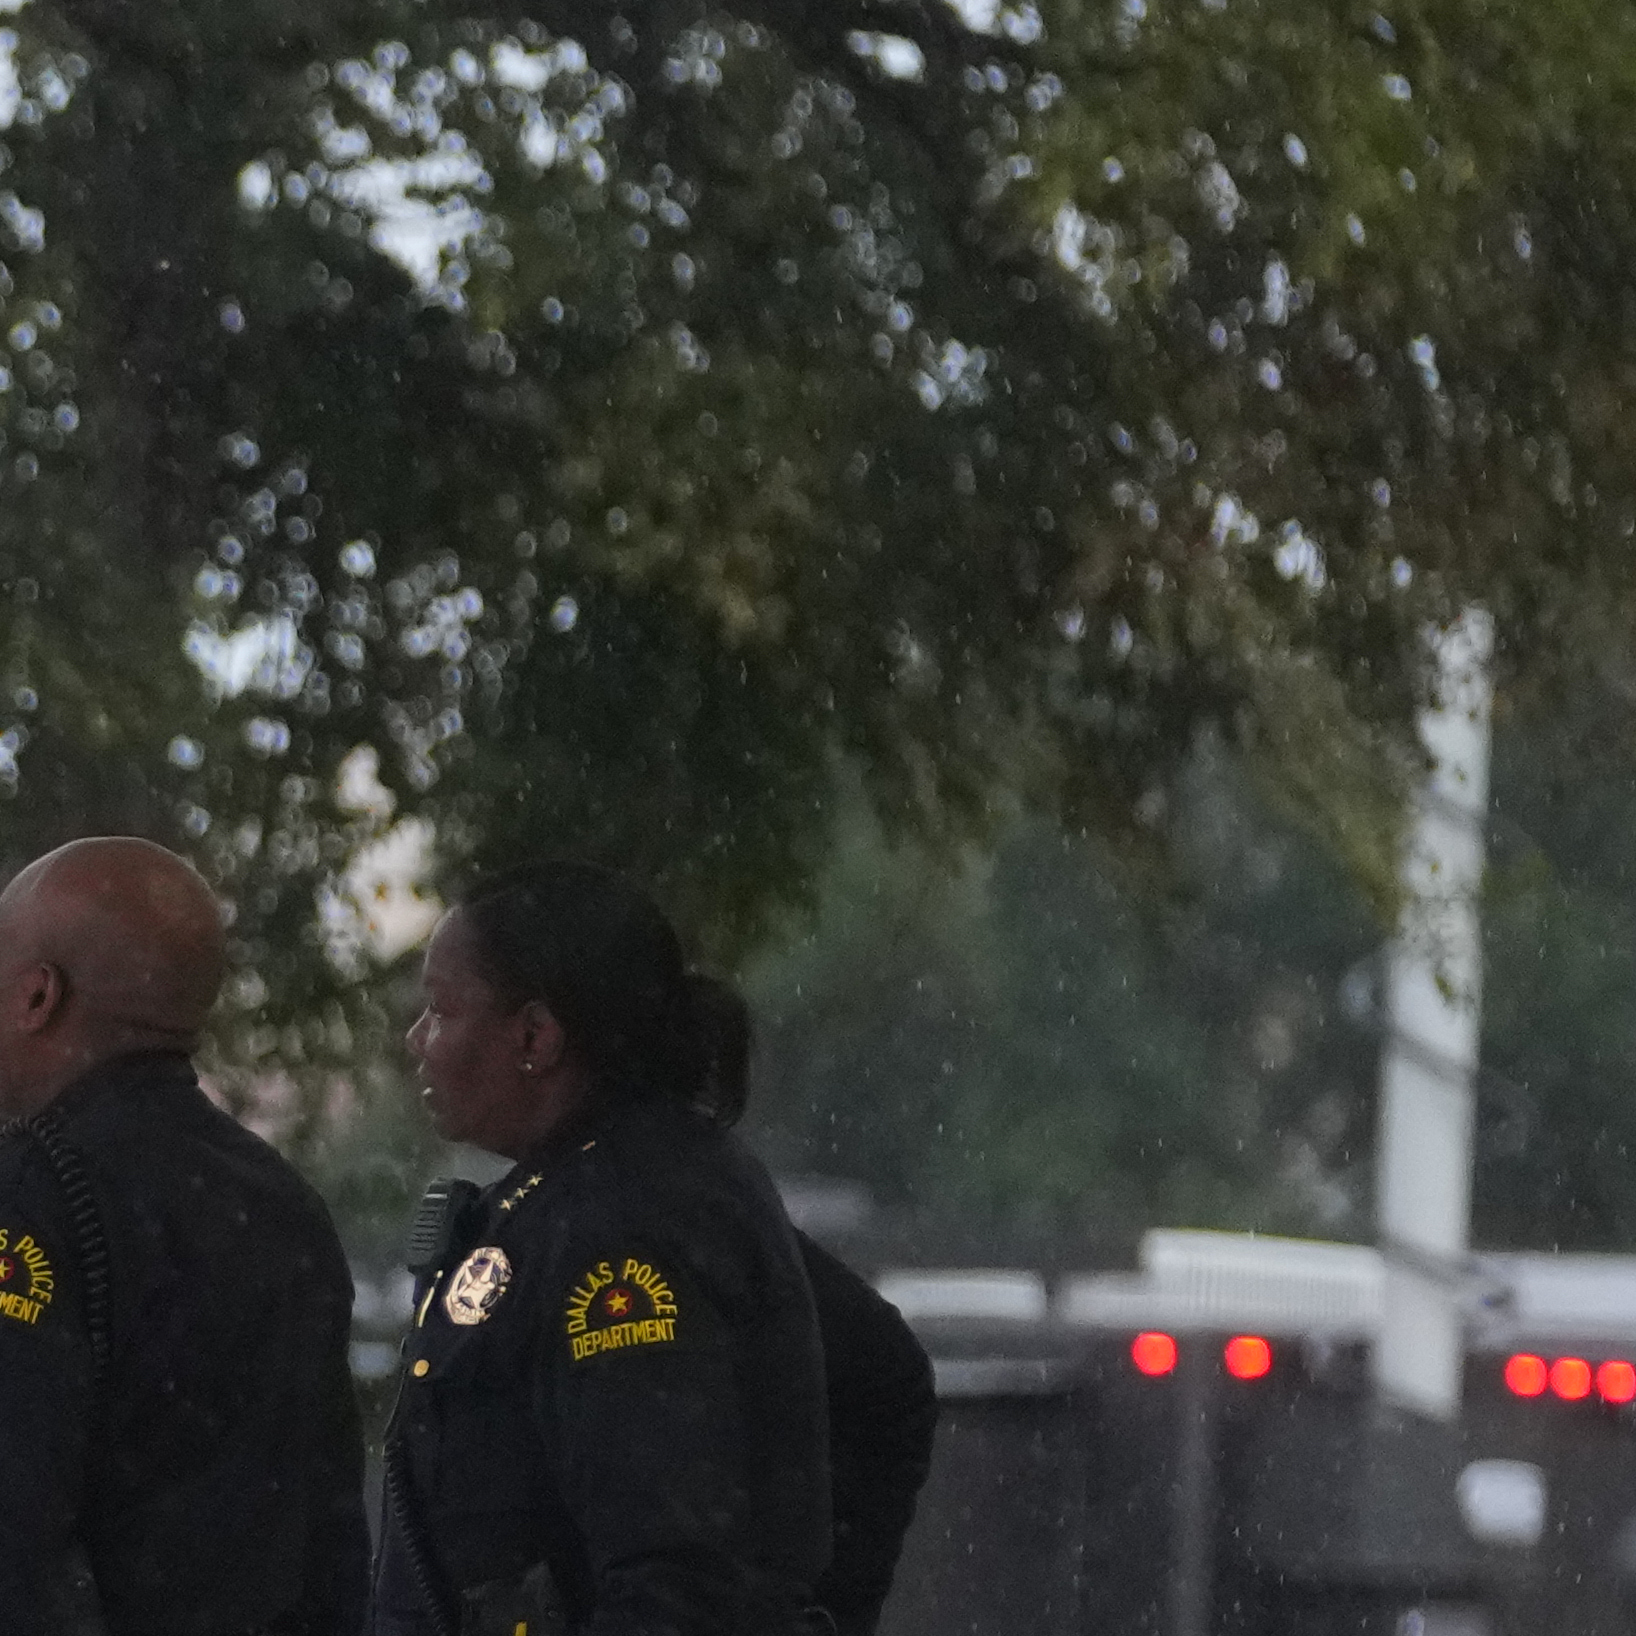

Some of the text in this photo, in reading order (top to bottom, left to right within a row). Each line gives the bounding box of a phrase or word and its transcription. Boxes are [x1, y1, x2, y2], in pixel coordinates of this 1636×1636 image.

[13, 1235, 55, 1304] POLICE
[566, 1257, 678, 1334] DALLAS POLICE
[571, 1318, 676, 1361] DEPARTMENT
